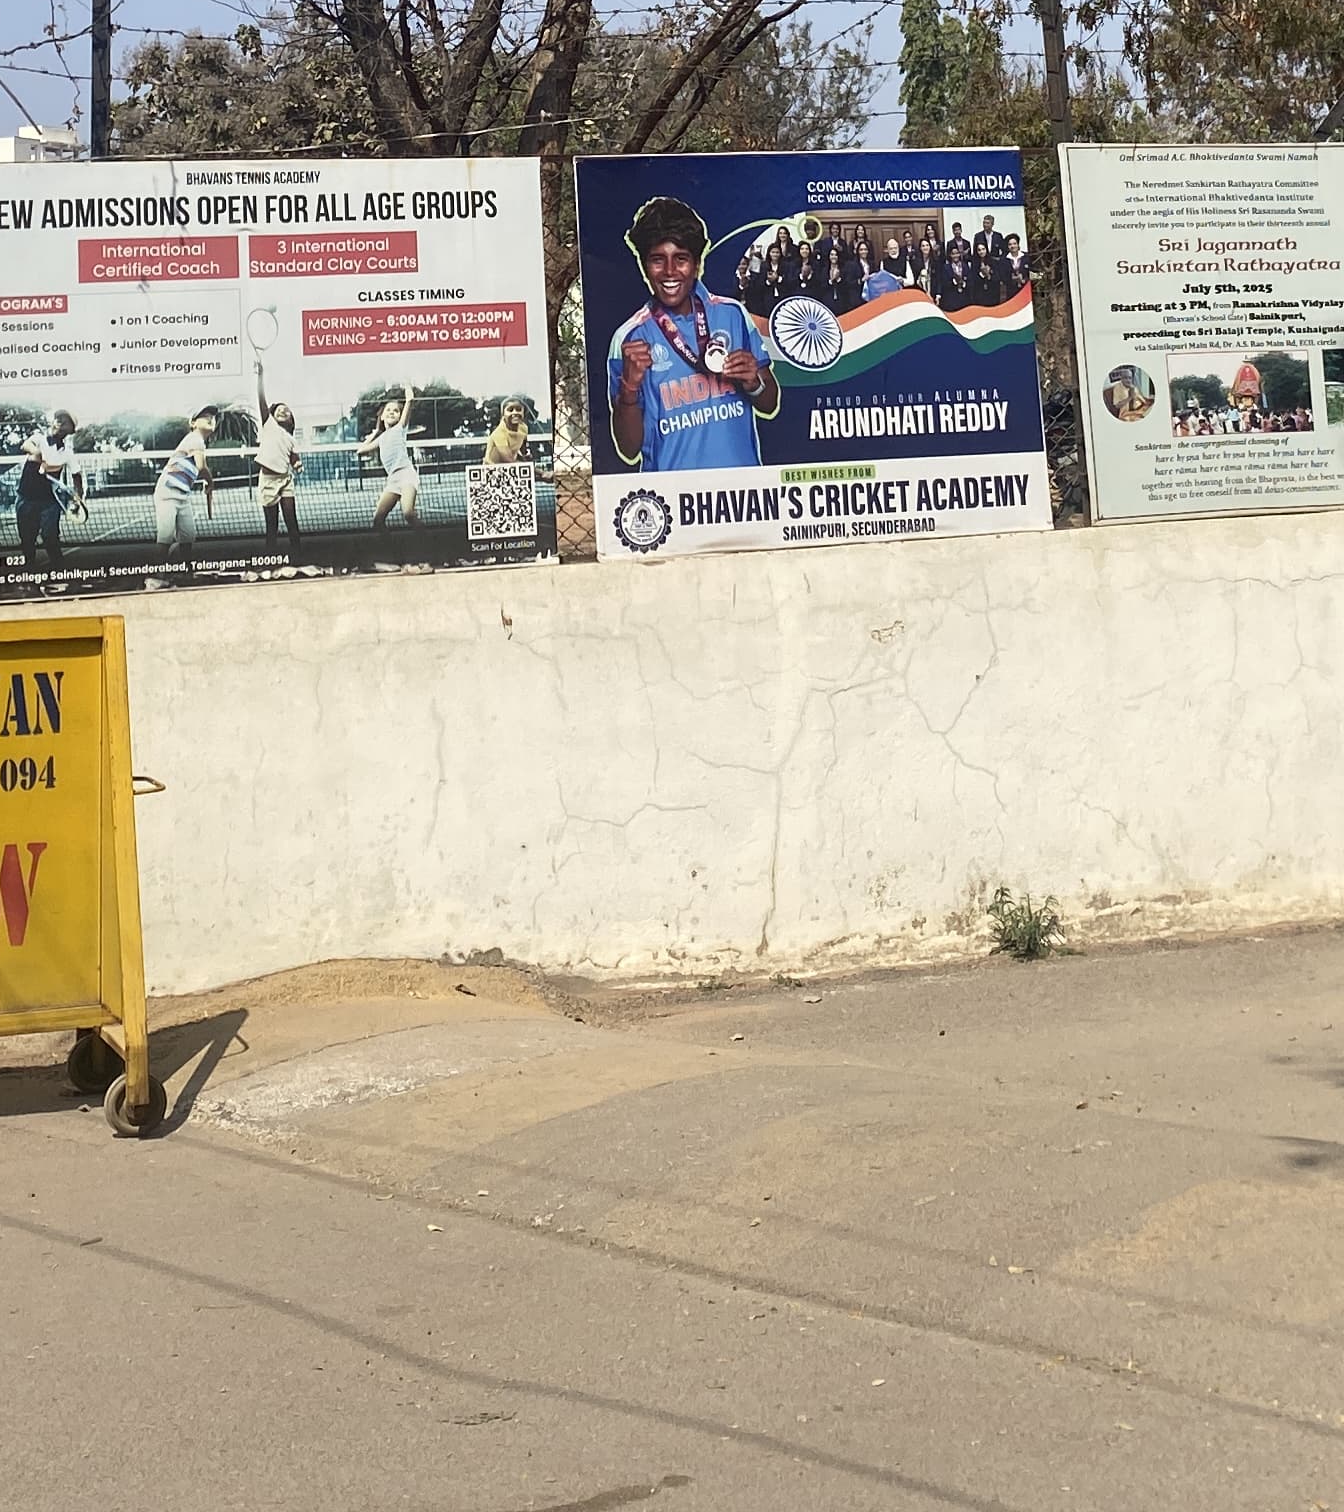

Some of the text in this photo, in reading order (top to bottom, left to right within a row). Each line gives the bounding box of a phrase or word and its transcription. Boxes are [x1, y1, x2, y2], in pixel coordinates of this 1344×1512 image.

[186, 170, 321, 185] BHAVANS TENNIS ACADEMY
[807, 175, 1015, 192] CONGRATULATIONS TEAM INDIA
[808, 191, 1016, 203] ICC WOMEN'S WORLD CUP 2025 CHAMPIONS!
[41, 196, 191, 229] ADMISSIONS
[197, 195, 258, 226] OPEN
[265, 194, 309, 224] FOR
[315, 193, 357, 222] ALL
[362, 192, 405, 221] AGE
[411, 190, 498, 220] GROUPS
[101, 241, 207, 259] International
[276, 237, 390, 255] 3 International
[1158, 237, 1297, 255] Sri Jagannath
[92, 259, 221, 278] Certified Coach
[249, 253, 418, 275] Standard Clay Courts
[1117, 258, 1341, 274] Sankirtan Rathayatra
[358, 289, 465, 302] CLASSES TIMING
[1183, 284, 1273, 295] July 5th, 2025
[1111, 302, 1162, 312] Starting
[1165, 302, 1177, 310] at
[1189, 301, 1211, 310] PM,
[2, 321, 54, 332] Sessions
[120, 314, 208, 326] 1 on 1 Coaching
[308, 316, 373, 330] MORNING
[387, 314, 438, 326] 6:00AM
[440, 313, 458, 325] TO
[462, 311, 514, 324] 12:00PM
[120, 336, 238, 350] Junior Development
[309, 333, 366, 347] EVENING
[380, 331, 429, 344] 2:30PM
[431, 330, 449, 341] TO
[42, 341, 101, 354] Coaching
[21, 368, 68, 378] Classes
[120, 360, 222, 374] Fitness Programs
[817, 388, 999, 406] PROUD OF OUR ALUMNA
[660, 401, 744, 435] CHAMPIONS
[810, 401, 1008, 439] ARUNDHATI REDDY
[785, 468, 872, 481] BEST WISHES FROM
[679, 485, 803, 525] BHAVAN'S
[809, 481, 911, 518] CRICKET
[916, 475, 1029, 512] ACADEMY
[783, 518, 936, 541] SAINIKPURI, SECUNDERABAD
[6, 555, 26, 566] 023
[7, 572, 48, 585] College
